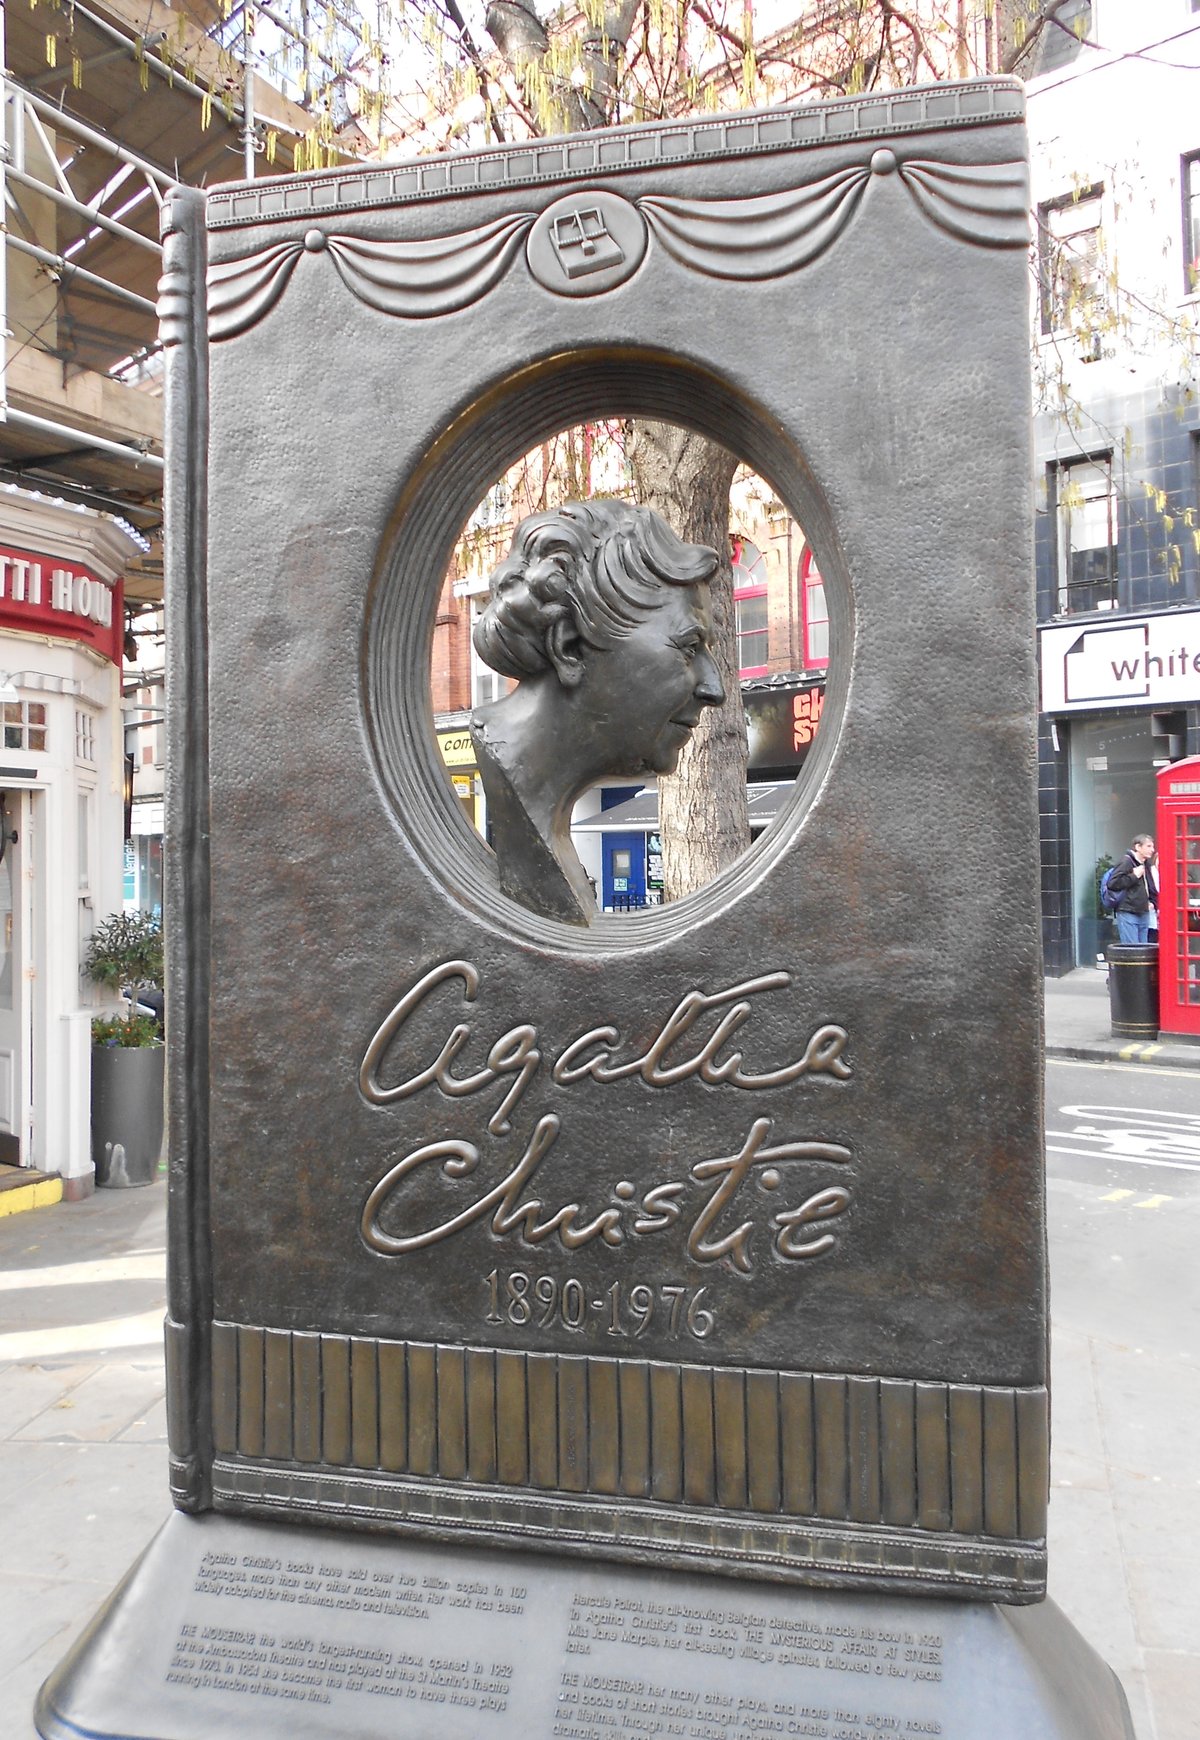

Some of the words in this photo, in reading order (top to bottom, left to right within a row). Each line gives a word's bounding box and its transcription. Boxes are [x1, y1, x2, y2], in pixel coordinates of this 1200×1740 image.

[52, 569, 113, 628] HOU
[359, 959, 854, 1136] Agatha
[361, 1113, 853, 1274] Christie
[485, 1268, 716, 1339] 1890-1976
[202, 1550, 236, 1566] Agatha
[242, 1554, 280, 1570] Christie's
[286, 1560, 314, 1574] books
[318, 1563, 342, 1577] have
[348, 1568, 367, 1580] sold
[373, 1572, 394, 1583] over
[398, 1572, 416, 1586] two
[422, 1575, 450, 1590] billion
[456, 1581, 488, 1595] copies
[494, 1583, 503, 1596] in
[251, 1573, 274, 1585] more
[278, 1574, 300, 1588] than
[303, 1580, 321, 1593] any
[326, 1580, 351, 1594] other
[354, 1584, 391, 1599] modern
[427, 1591, 444, 1605] Her
[449, 1596, 471, 1608] work
[475, 1597, 493, 1611] has
[497, 1600, 524, 1615] been
[225, 1583, 265, 1600] adapted
[266, 1588, 279, 1601] for
[280, 1590, 296, 1603] the
[336, 1598, 361, 1611] radio
[362, 1601, 382, 1614] and
[383, 1602, 430, 1620] television.
[572, 1592, 611, 1608] Hercule
[648, 1601, 664, 1615] the
[667, 1604, 725, 1625] all-knowing
[728, 1611, 766, 1628] Belgian
[769, 1616, 822, 1634] detective,
[825, 1624, 856, 1637] made
[860, 1626, 873, 1639] his
[877, 1628, 901, 1643] bow
[904, 1632, 914, 1644] in
[918, 1633, 942, 1648] 1920
[180, 1624, 197, 1638] THE
[259, 1634, 276, 1648] the
[281, 1639, 313, 1653] world's
[318, 1642, 392, 1666] longest-running
[429, 1659, 469, 1673] opened
[473, 1662, 483, 1675] in
[490, 1664, 513, 1678] 1952
[567, 1624, 589, 1639] Miss
[592, 1627, 618, 1642] Jane
[663, 1636, 682, 1650] her
[685, 1640, 735, 1659] all-seeing
[740, 1646, 774, 1664] village
[824, 1656, 871, 1673] followed
[874, 1665, 883, 1675] a
[887, 1664, 908, 1678] few
[912, 1670, 942, 1682] years
[569, 1608, 580, 1621] in
[586, 1610, 625, 1626] Agatha
[631, 1616, 677, 1633] Christie's
[684, 1622, 703, 1636] first
[745, 1629, 763, 1643] THE
[770, 1633, 834, 1652] MYSTERIOUS
[840, 1641, 877, 1657] AFFAIR
[883, 1646, 898, 1660] AT
[164, 1672, 200, 1688] running
[201, 1674, 211, 1687] in
[213, 1676, 248, 1692] London
[250, 1682, 261, 1694] at
[262, 1683, 278, 1697] the
[280, 1689, 306, 1701] same
[308, 1690, 331, 1704] time.
[175, 1640, 187, 1652] at
[188, 1641, 204, 1654] the
[205, 1643, 268, 1662] Ambassadors
[270, 1651, 304, 1667] Theatre
[307, 1658, 327, 1670] and
[328, 1659, 346, 1673] has
[348, 1662, 383, 1679] played
[385, 1667, 398, 1679] at
[399, 1668, 415, 1681] the
[418, 1670, 429, 1683] St
[430, 1672, 469, 1688] Martin's
[472, 1677, 510, 1694] Theatre
[262, 1668, 279, 1681] she
[280, 1669, 322, 1686] became
[326, 1675, 342, 1689] the
[346, 1678, 364, 1692] first
[367, 1684, 401, 1697] woman
[406, 1686, 416, 1699] to
[420, 1688, 446, 1703] have
[450, 1692, 477, 1707] three
[479, 1696, 507, 1713] plays
[554, 1706, 573, 1720] her
[576, 1709, 617, 1726] lifetime.
[621, 1715, 662, 1734] Through
[667, 1721, 686, 1735] her
[558, 1691, 580, 1704] and
[582, 1692, 613, 1708] books
[616, 1698, 628, 1710] of
[630, 1700, 657, 1714] short
[659, 1704, 694, 1719] stories
[696, 1708, 740, 1727] brought
[742, 1714, 784, 1732] Agatha
[787, 1721, 829, 1738] Christie
[560, 1673, 579, 1687] THE
[647, 1684, 666, 1698] her
[669, 1690, 700, 1706] many
[703, 1692, 734, 1707] other
[772, 1703, 797, 1715] and
[800, 1707, 830, 1720] more
[833, 1709, 860, 1724] than
[863, 1713, 900, 1732] eighty
[904, 1721, 942, 1734] novels
